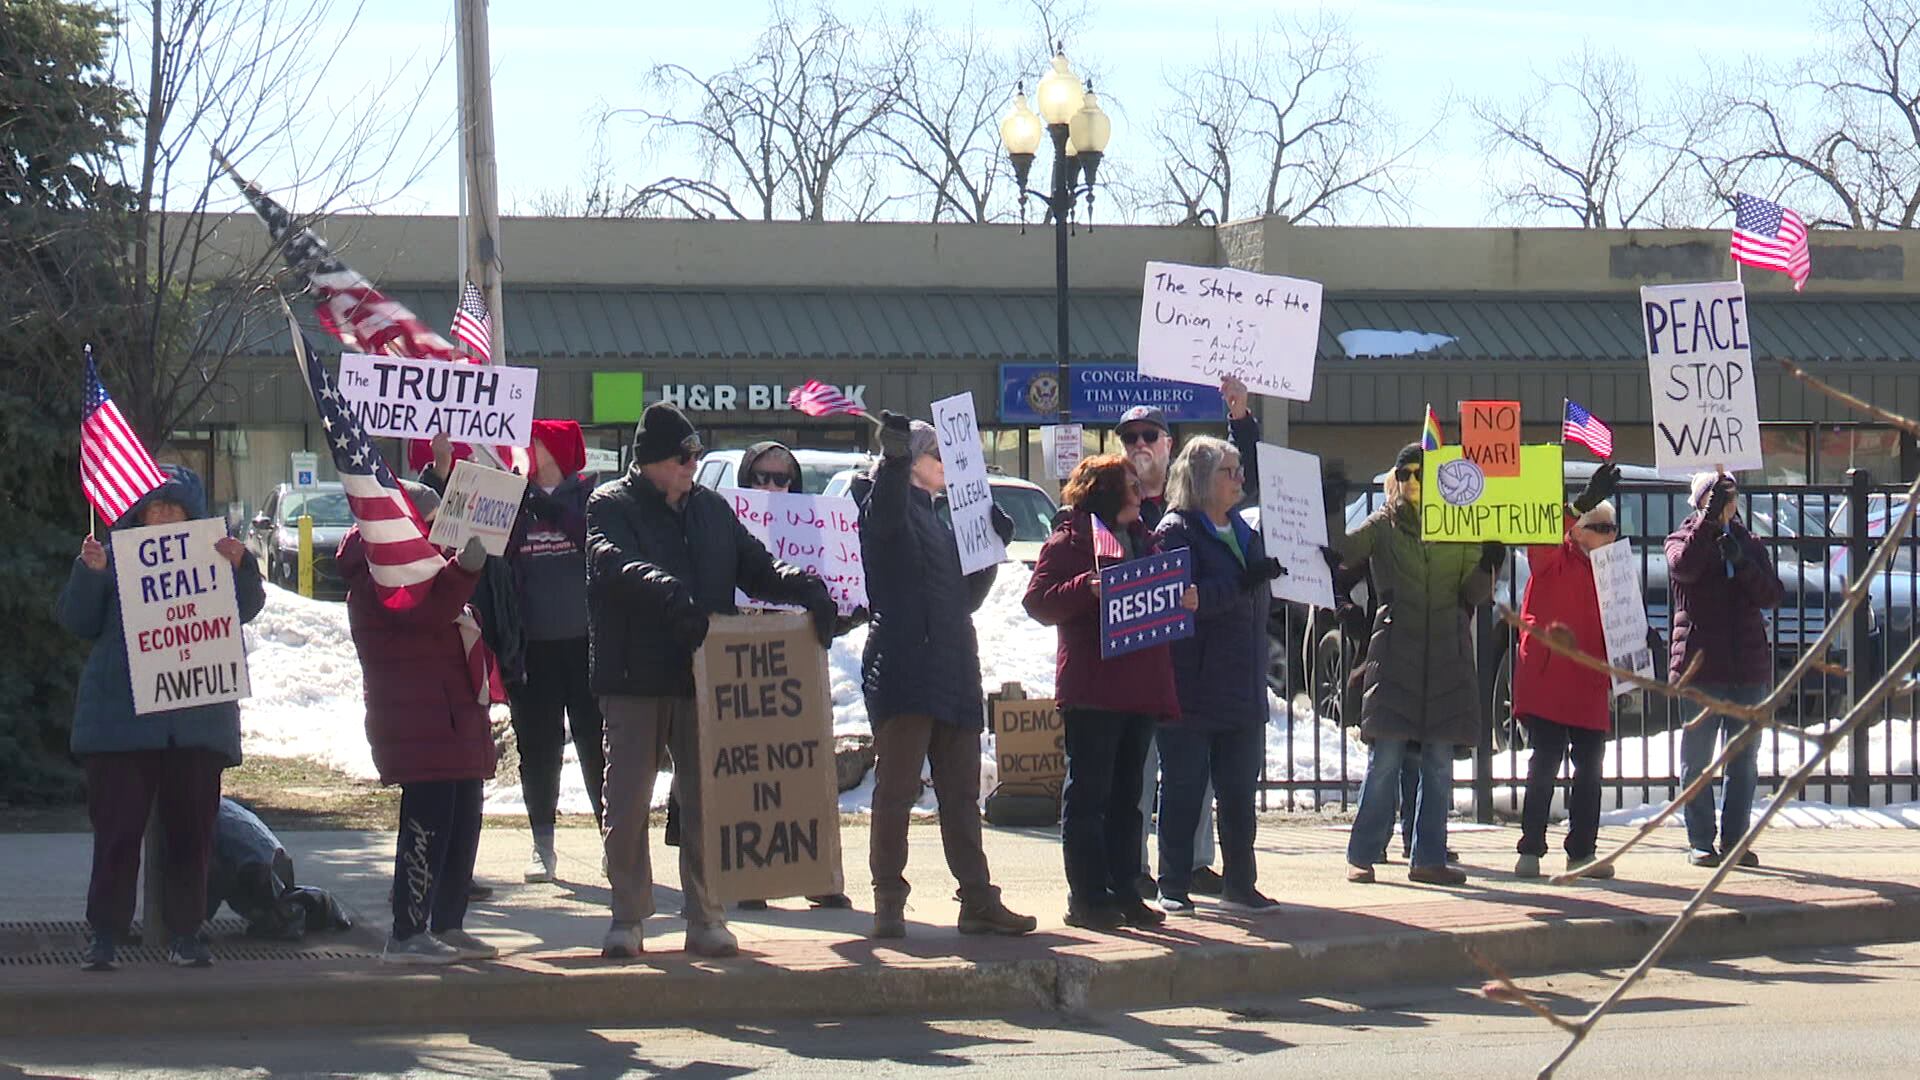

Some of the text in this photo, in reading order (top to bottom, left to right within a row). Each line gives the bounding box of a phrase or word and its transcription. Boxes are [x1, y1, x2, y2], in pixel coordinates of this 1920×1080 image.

[1155, 273, 1309, 312] The State of the
[1155, 302, 1210, 329] Union
[1646, 297, 1748, 354] PEACE
[1209, 352, 1226, 363] At
[1210, 336, 1256, 354] Awful
[346, 363, 522, 406] The TRUTH is
[1084, 388, 1193, 402] TIM WALBERG
[1666, 362, 1743, 401] STOP
[662, 384, 867, 411] H&R BLK
[1697, 401, 1732, 414] the
[425, 408, 516, 440] ATTACK
[940, 407, 972, 446] STOP
[1473, 406, 1516, 431] NO
[1658, 417, 1743, 456] WAR
[1463, 442, 1516, 464] WAR!
[948, 480, 988, 511] ILLEGAL
[787, 508, 859, 533] Walbe
[960, 515, 993, 556] WAR
[139, 532, 190, 568] GET
[835, 543, 858, 563] Jo
[141, 564, 217, 604] REAL!
[166, 603, 197, 621] OUR
[138, 616, 231, 653] ECONOMY
[180, 648, 191, 662] IS
[725, 640, 788, 678] THE
[154, 661, 238, 703] AWFUL!
[715, 679, 803, 721] FILES
[1002, 709, 1063, 733] DEMO
[713, 740, 819, 779] ARE NOT
[1001, 752, 1067, 773] DICTAT
[753, 781, 782, 811] IN
[720, 819, 819, 872] IRAN
